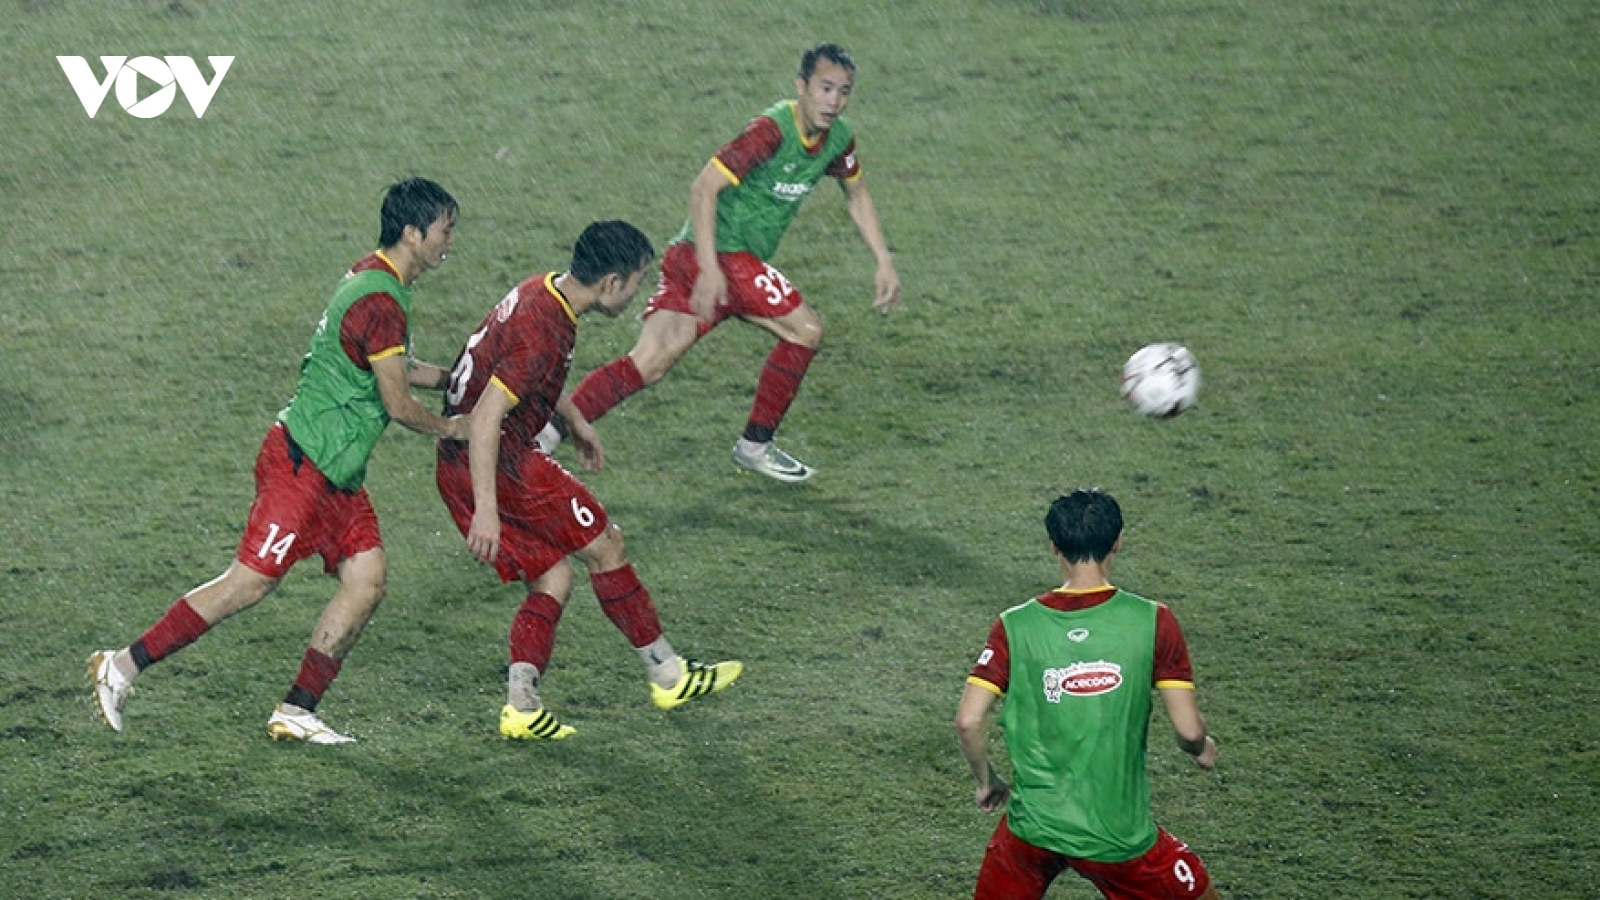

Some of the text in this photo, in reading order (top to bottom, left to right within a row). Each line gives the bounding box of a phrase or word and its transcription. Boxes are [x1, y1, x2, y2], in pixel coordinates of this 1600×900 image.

[754, 263, 792, 305] 32
[571, 497, 595, 528] 6
[258, 523, 296, 565] 14
[1174, 859, 1195, 892] 9
